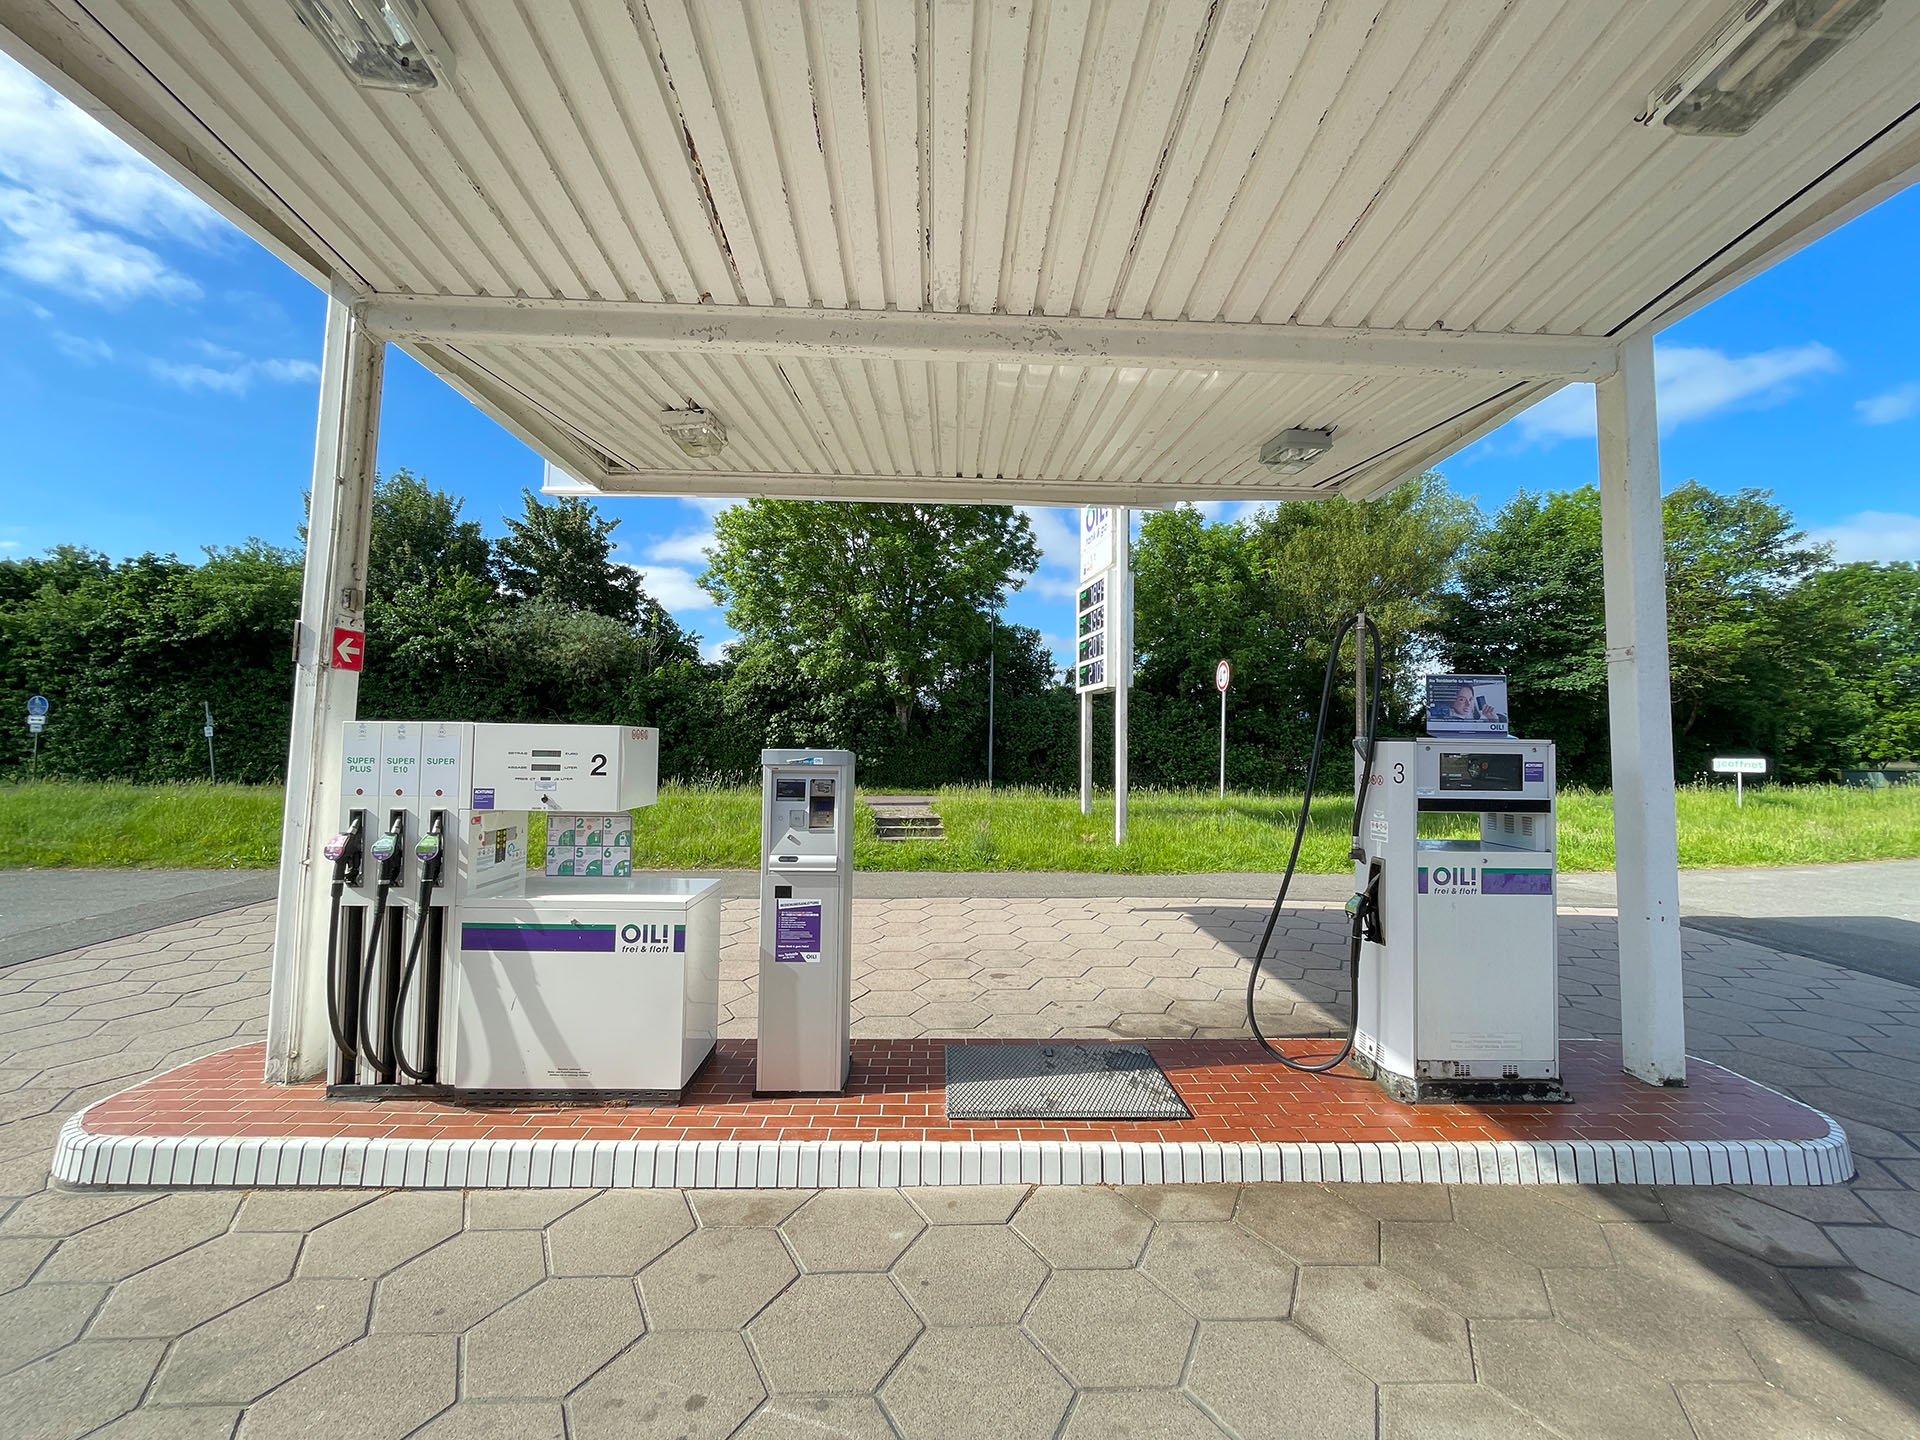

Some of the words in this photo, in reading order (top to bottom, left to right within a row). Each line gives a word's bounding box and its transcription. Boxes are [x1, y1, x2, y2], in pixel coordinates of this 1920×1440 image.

[1086, 507, 1108, 532] OIL
[387, 757, 415, 765] SUPER
[590, 754, 607, 776] 2
[1393, 763, 1405, 784] 3
[549, 818, 553, 828] 1
[577, 818, 584, 828] 2
[605, 818, 612, 828] 3
[548, 848, 555, 857] 4
[576, 848, 583, 858] 5
[604, 848, 611, 858] 6
[1433, 867, 1476, 885] OIL!
[621, 924, 668, 944] OIL!
